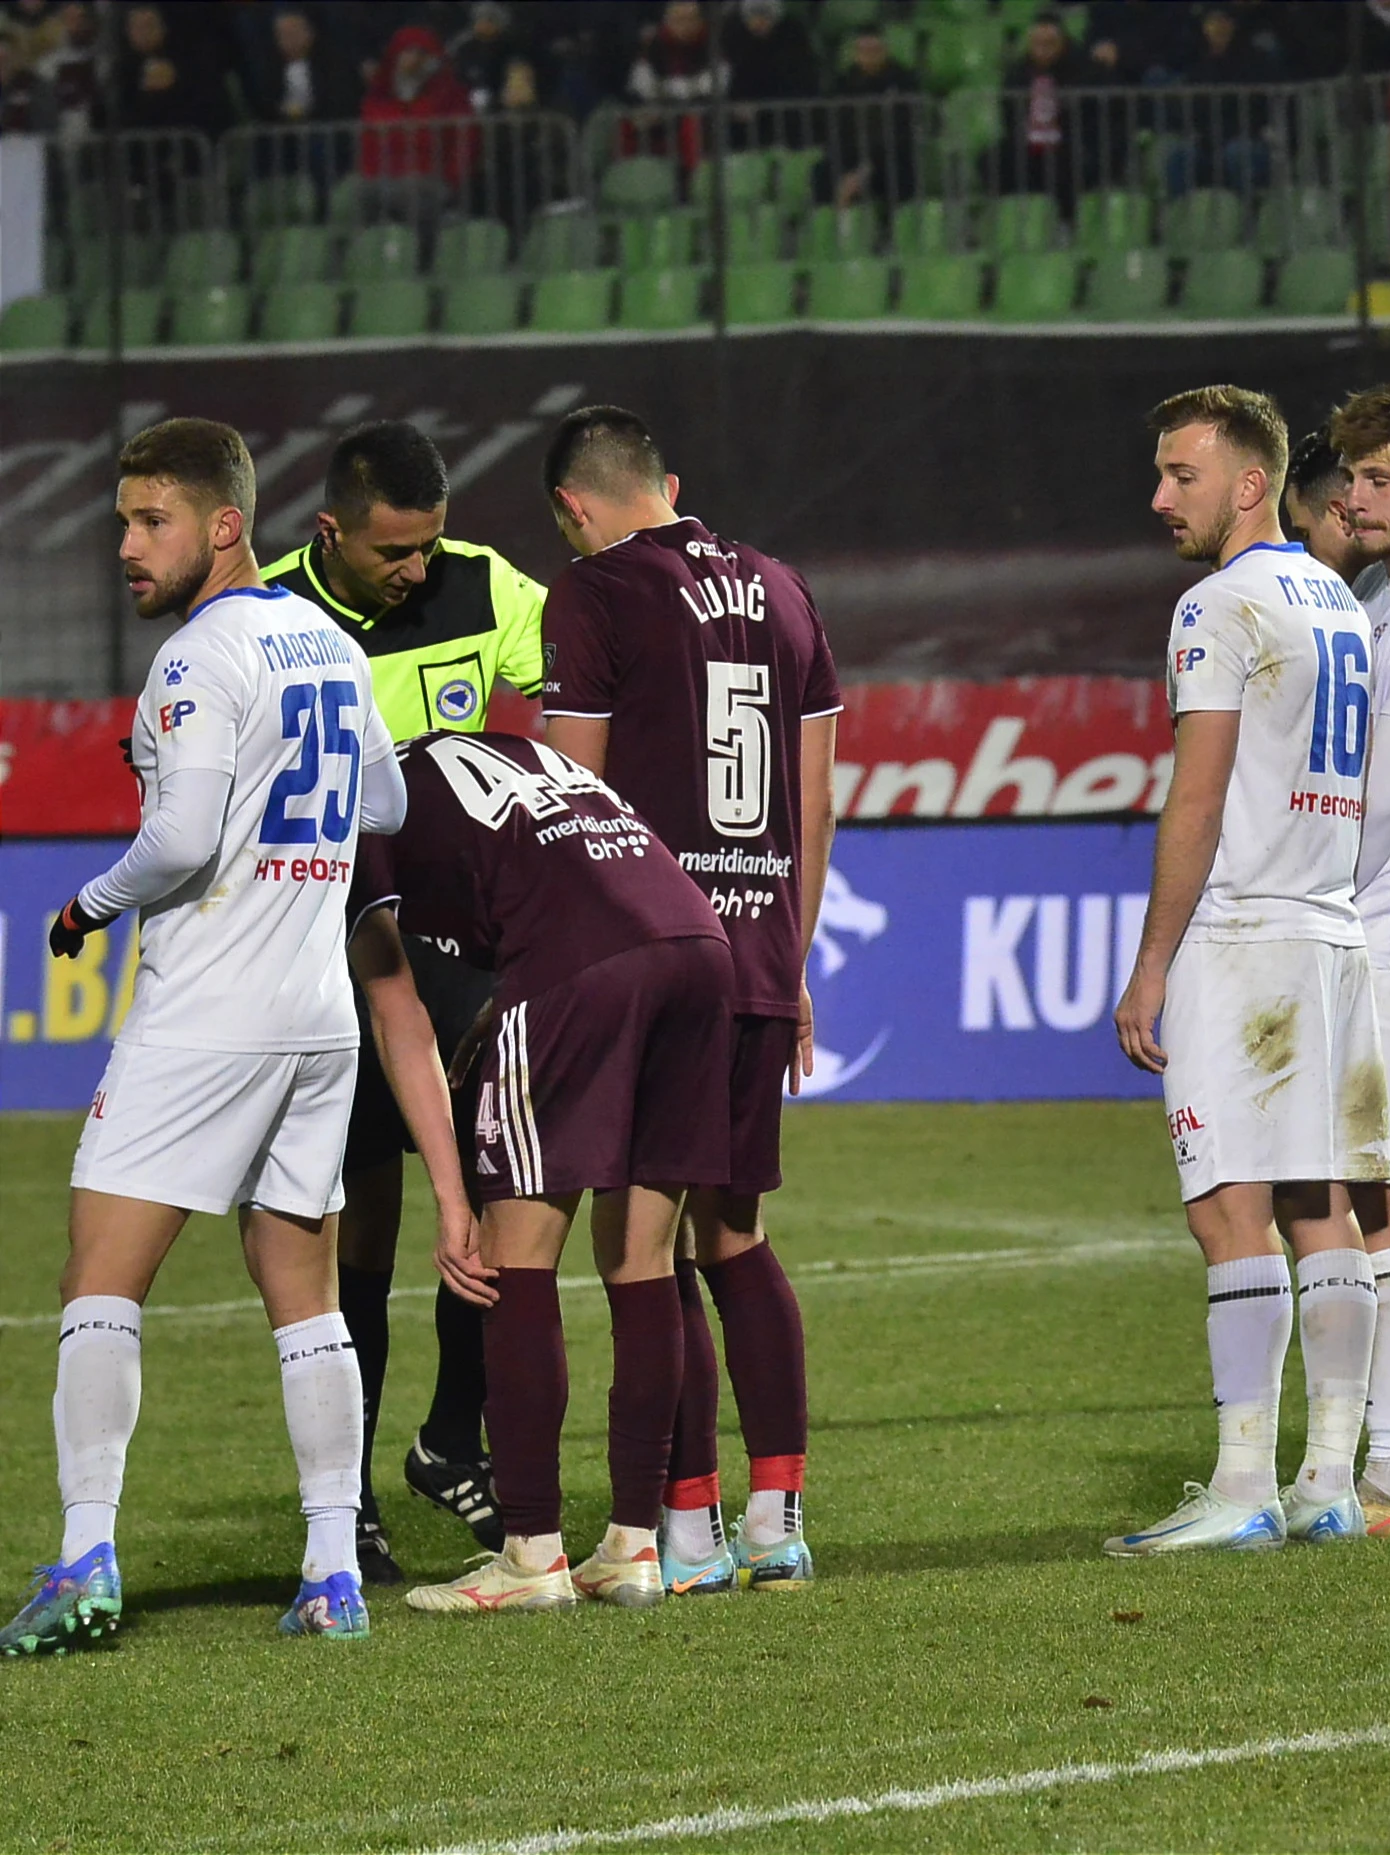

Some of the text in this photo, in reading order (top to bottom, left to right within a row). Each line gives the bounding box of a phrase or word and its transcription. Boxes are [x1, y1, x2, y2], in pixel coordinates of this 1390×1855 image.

[680, 574, 765, 623] LULIĆ
[1275, 575, 1309, 606] M.
[1176, 647, 1206, 673] EP
[160, 699, 196, 733] EP
[1309, 627, 1369, 778] 16
[259, 681, 360, 844] 25
[706, 661, 771, 837] 5
[535, 813, 650, 846] meridianbe
[678, 847, 792, 878] meridianbet
[281, 1343, 342, 1364] KELME
